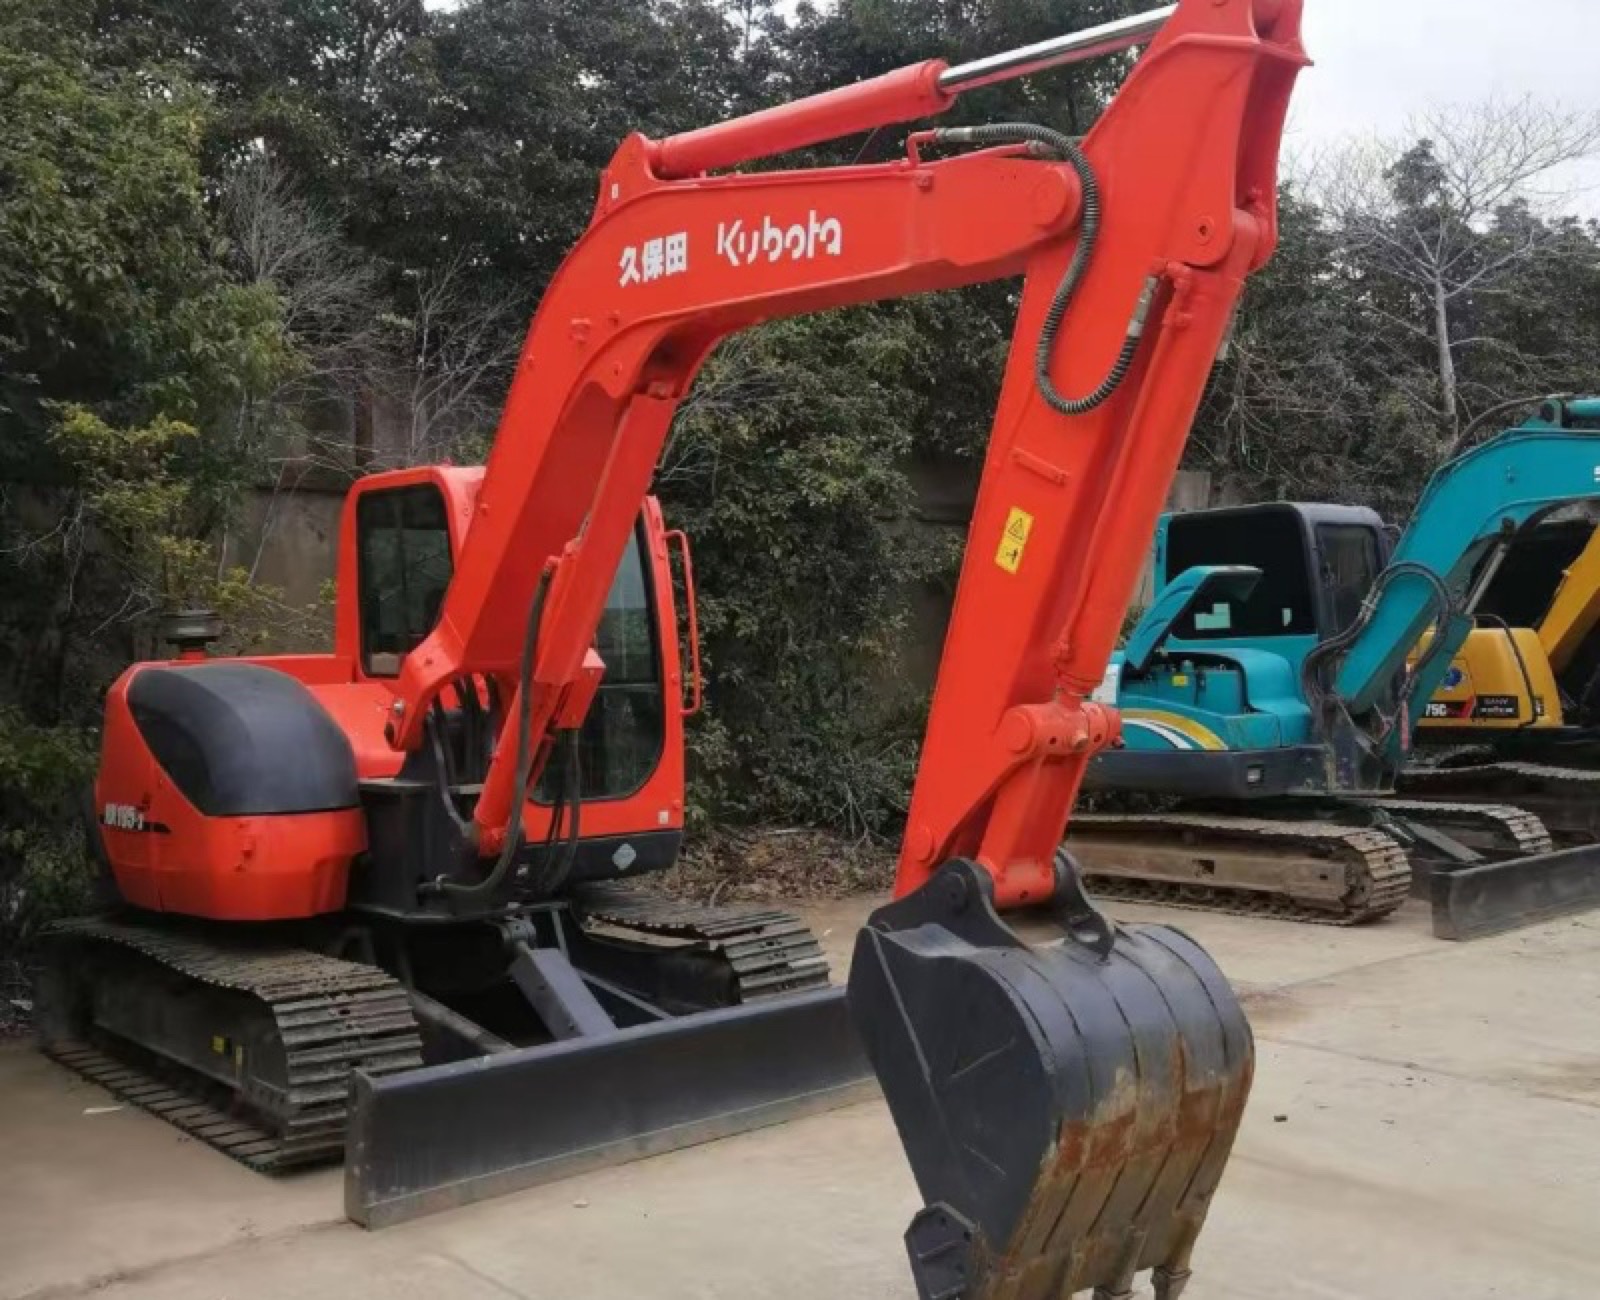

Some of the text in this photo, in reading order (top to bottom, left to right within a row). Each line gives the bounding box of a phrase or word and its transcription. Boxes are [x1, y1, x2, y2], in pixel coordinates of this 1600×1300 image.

[619, 209, 842, 288] 久保田 Kubota
